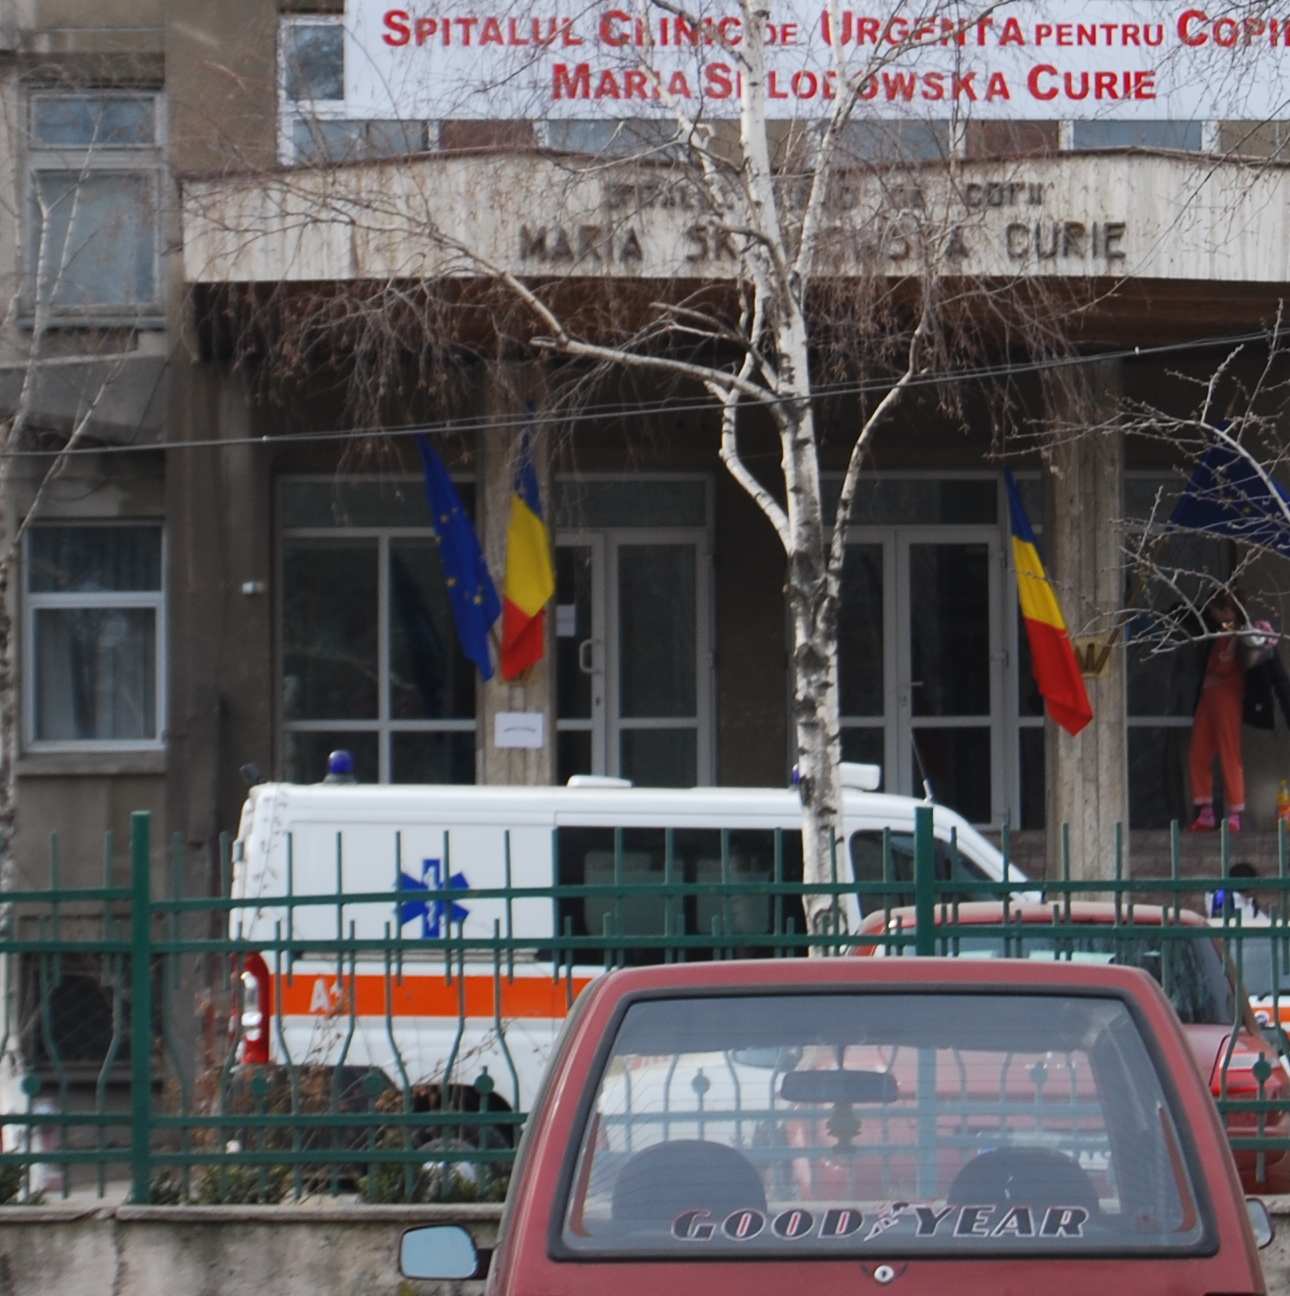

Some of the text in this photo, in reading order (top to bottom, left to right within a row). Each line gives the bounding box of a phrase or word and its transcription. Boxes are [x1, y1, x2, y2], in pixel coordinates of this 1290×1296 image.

[382, 8, 583, 47] SPITALUL
[1035, 23, 1164, 47] PENTRU
[1027, 63, 1157, 101] CURIE
[1005, 220, 1127, 260] CURIE
